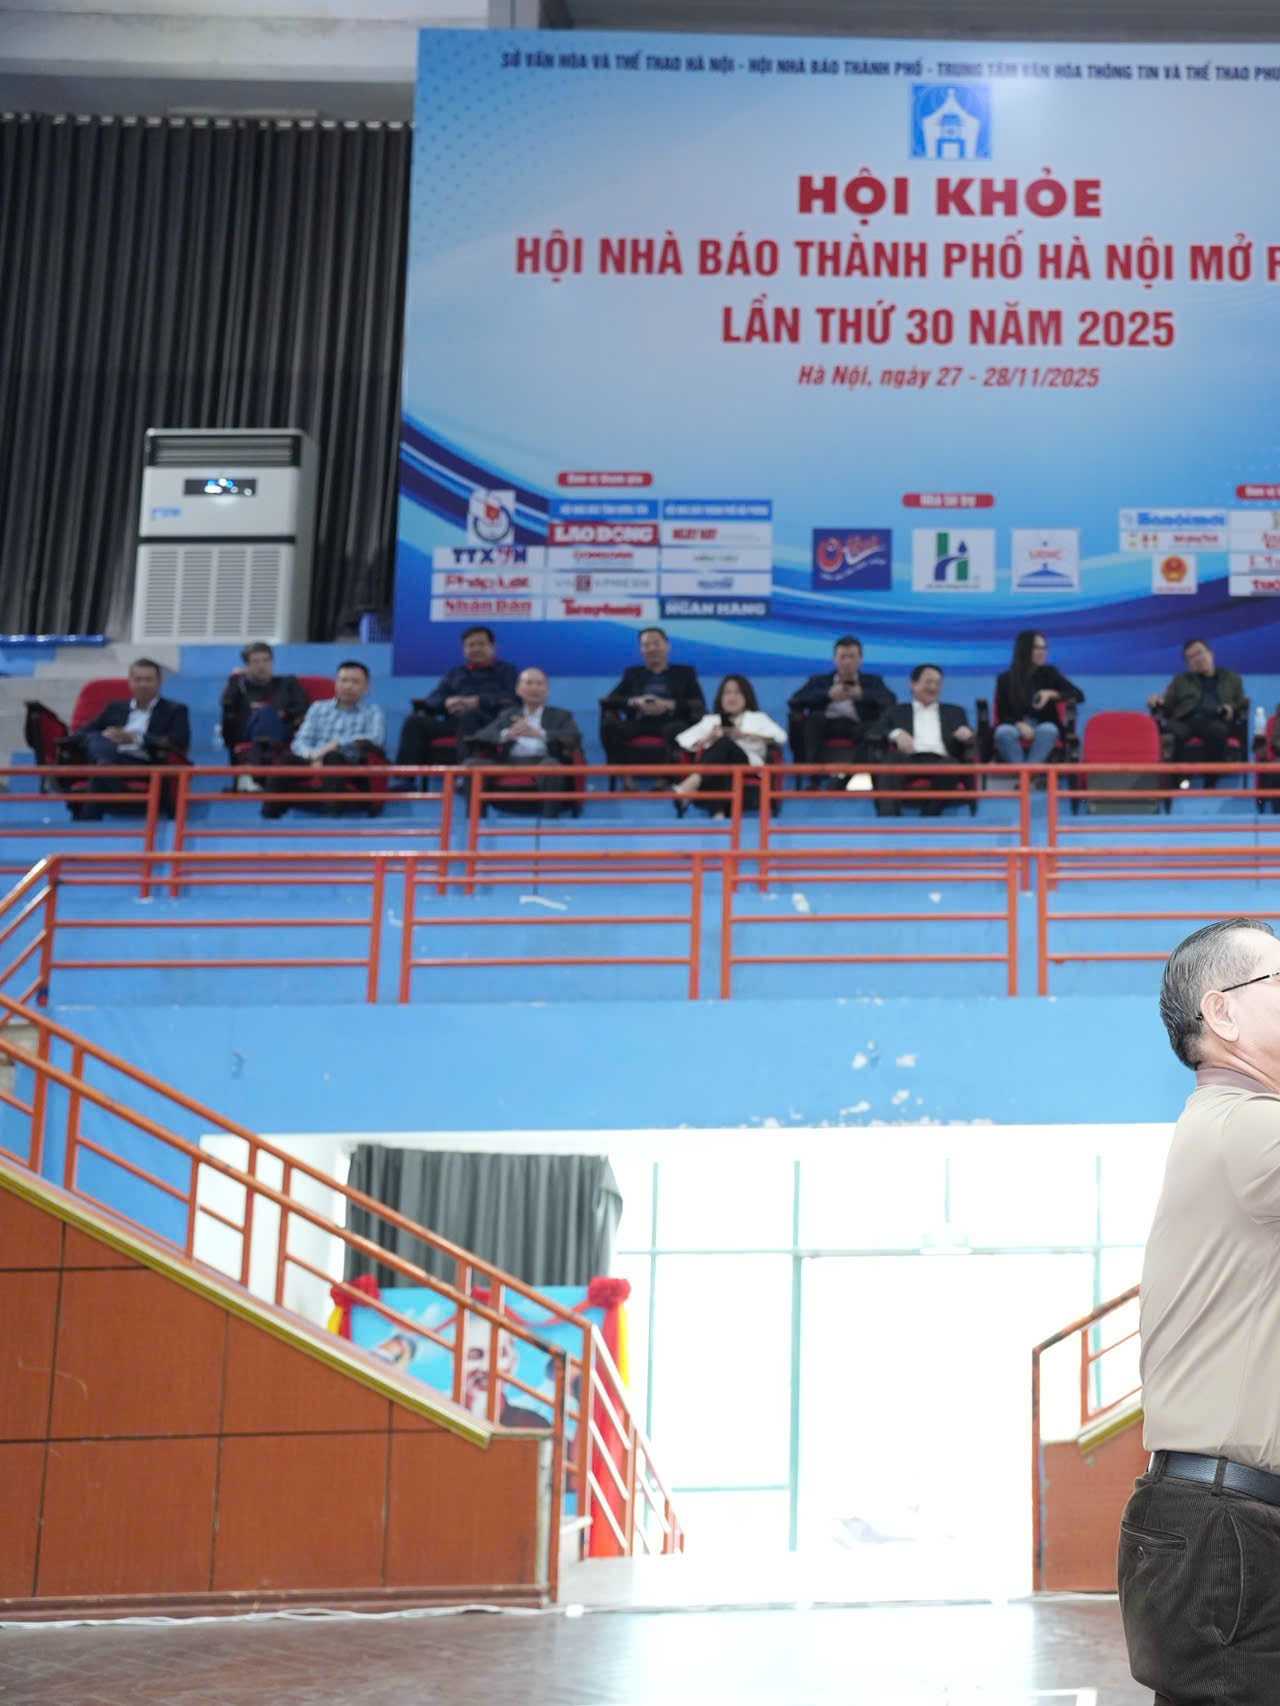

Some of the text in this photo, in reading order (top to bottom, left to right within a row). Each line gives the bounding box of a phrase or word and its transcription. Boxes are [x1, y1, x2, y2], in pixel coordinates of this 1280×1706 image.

[646, 54, 681, 71] THAO
[685, 53, 705, 71] HÀ
[709, 53, 735, 75] NỘI
[776, 57, 805, 74] NHÀ
[810, 57, 838, 75] BÁO
[844, 57, 890, 76] THÀNH
[1087, 62, 1132, 80] THÔNG
[1137, 65, 1158, 80] TIN
[1215, 65, 1249, 81] THAO
[798, 167, 1102, 226] HỘI KHỎE
[516, 229, 583, 283] HỘI
[599, 230, 683, 275] NHÀ
[699, 231, 780, 277] BÁO
[794, 233, 928, 279] THÀNH
[944, 230, 1023, 280] PHỐ
[1039, 235, 1092, 280] HÀ
[1106, 236, 1174, 289] NỘI
[1189, 232, 1254, 282] MỞ
[722, 293, 1176, 348] LẦN THỨ 30 NĂM 2025
[798, 364, 826, 386] Hà
[831, 364, 873, 390] Nội,
[880, 366, 931, 389] ngày
[936, 366, 964, 386] 27
[983, 366, 1100, 388] 28/11/2025
